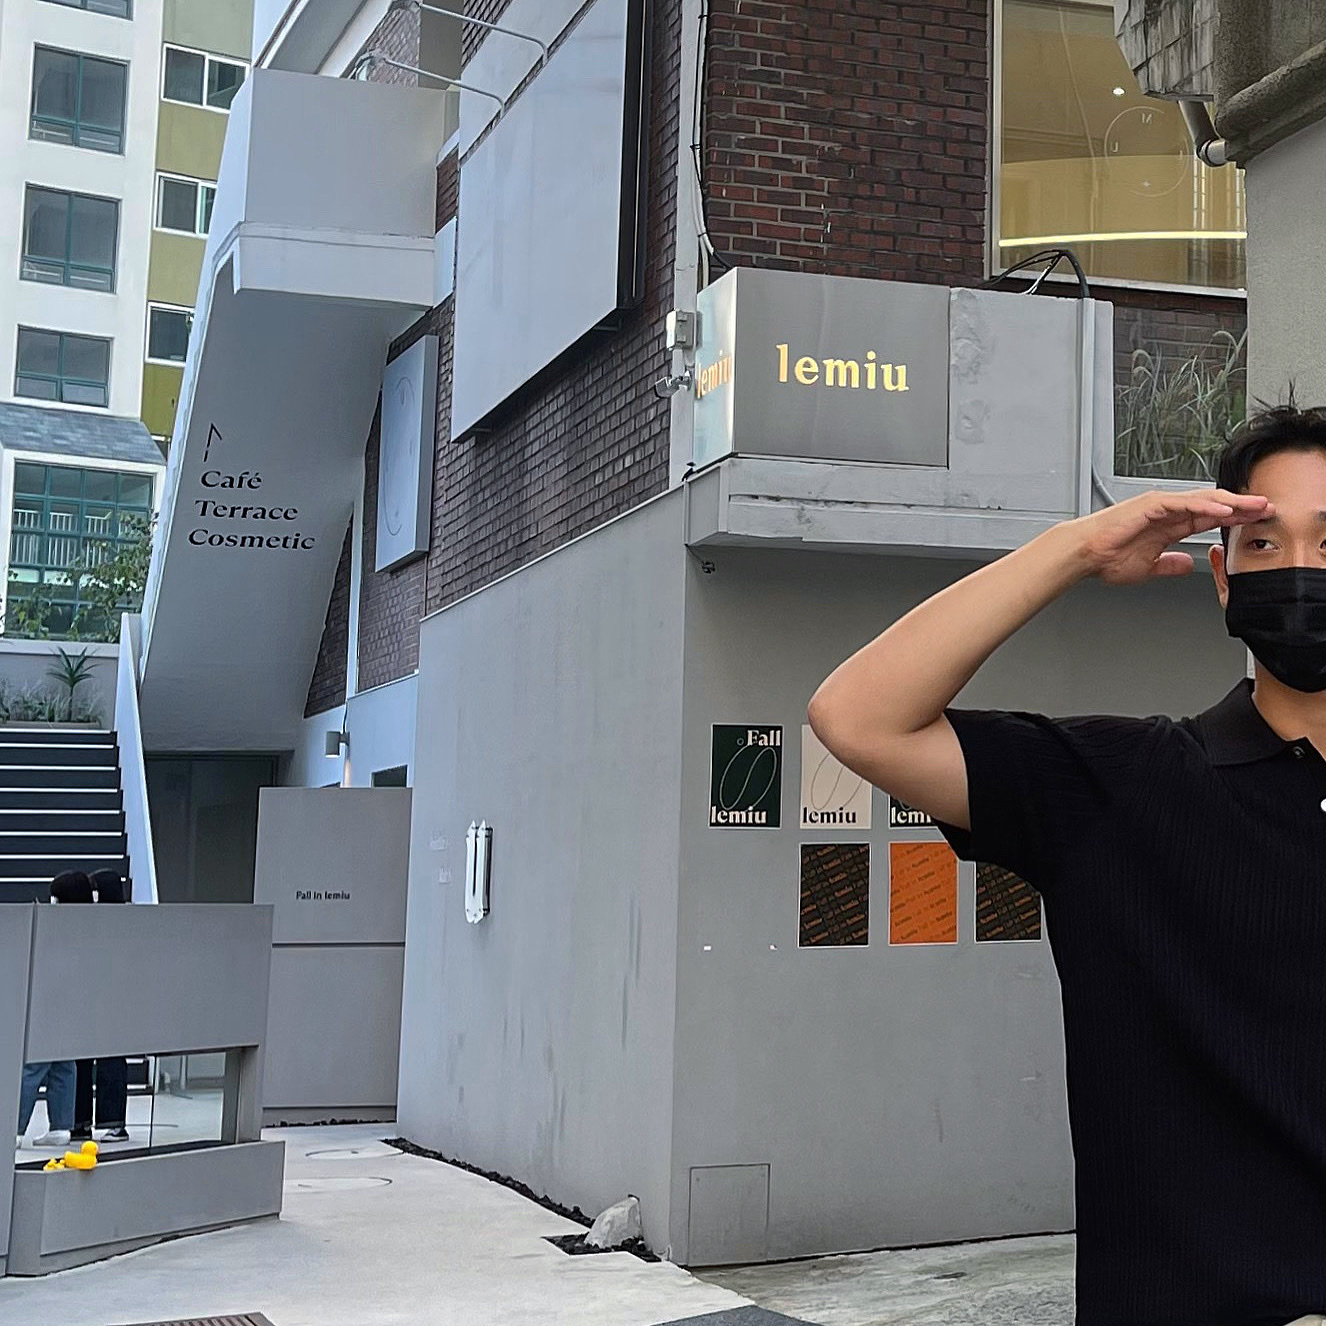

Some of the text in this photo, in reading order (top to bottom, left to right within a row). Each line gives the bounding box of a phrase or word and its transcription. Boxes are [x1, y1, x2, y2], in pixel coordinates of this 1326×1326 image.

[775, 343, 910, 392] lemiu
[201, 470, 262, 489] Café
[195, 500, 298, 520] Terrace
[188, 528, 316, 549] Cosmetic
[747, 730, 781, 746] Fall
[711, 806, 767, 824] lemiu
[802, 806, 857, 824] lemiu
